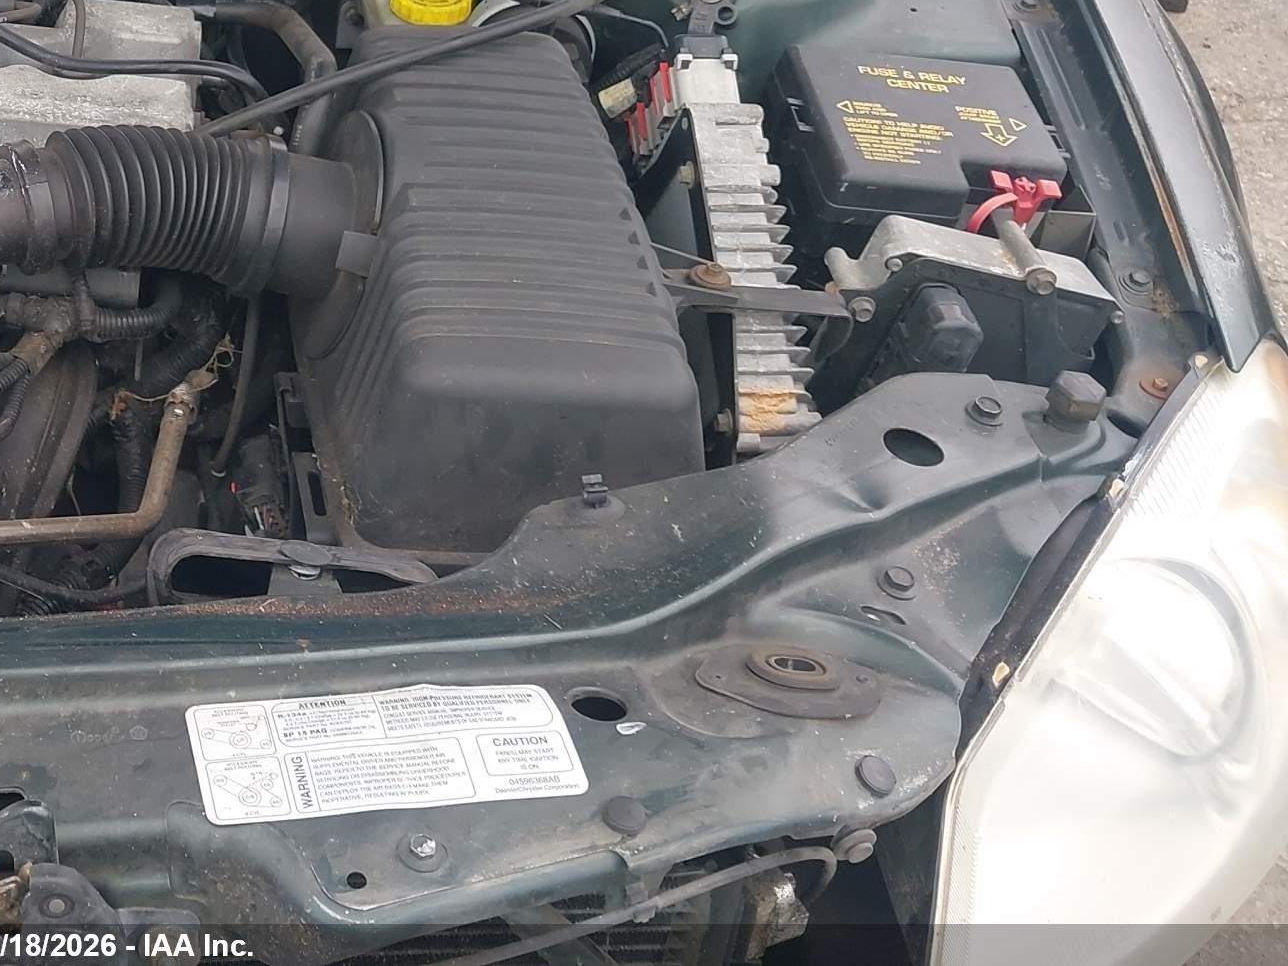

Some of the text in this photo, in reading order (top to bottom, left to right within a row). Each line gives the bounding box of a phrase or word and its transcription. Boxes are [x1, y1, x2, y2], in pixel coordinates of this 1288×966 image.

[857, 65, 966, 85] FUSE & RELAY
[886, 78, 950, 93] CENTER
[298, 699, 347, 711] ATTENTION
[492, 736, 548, 747] CAUTION
[529, 754, 559, 762] IGNITION
[291, 755, 314, 810] WARNING
[543, 783, 579, 791] Corporation
